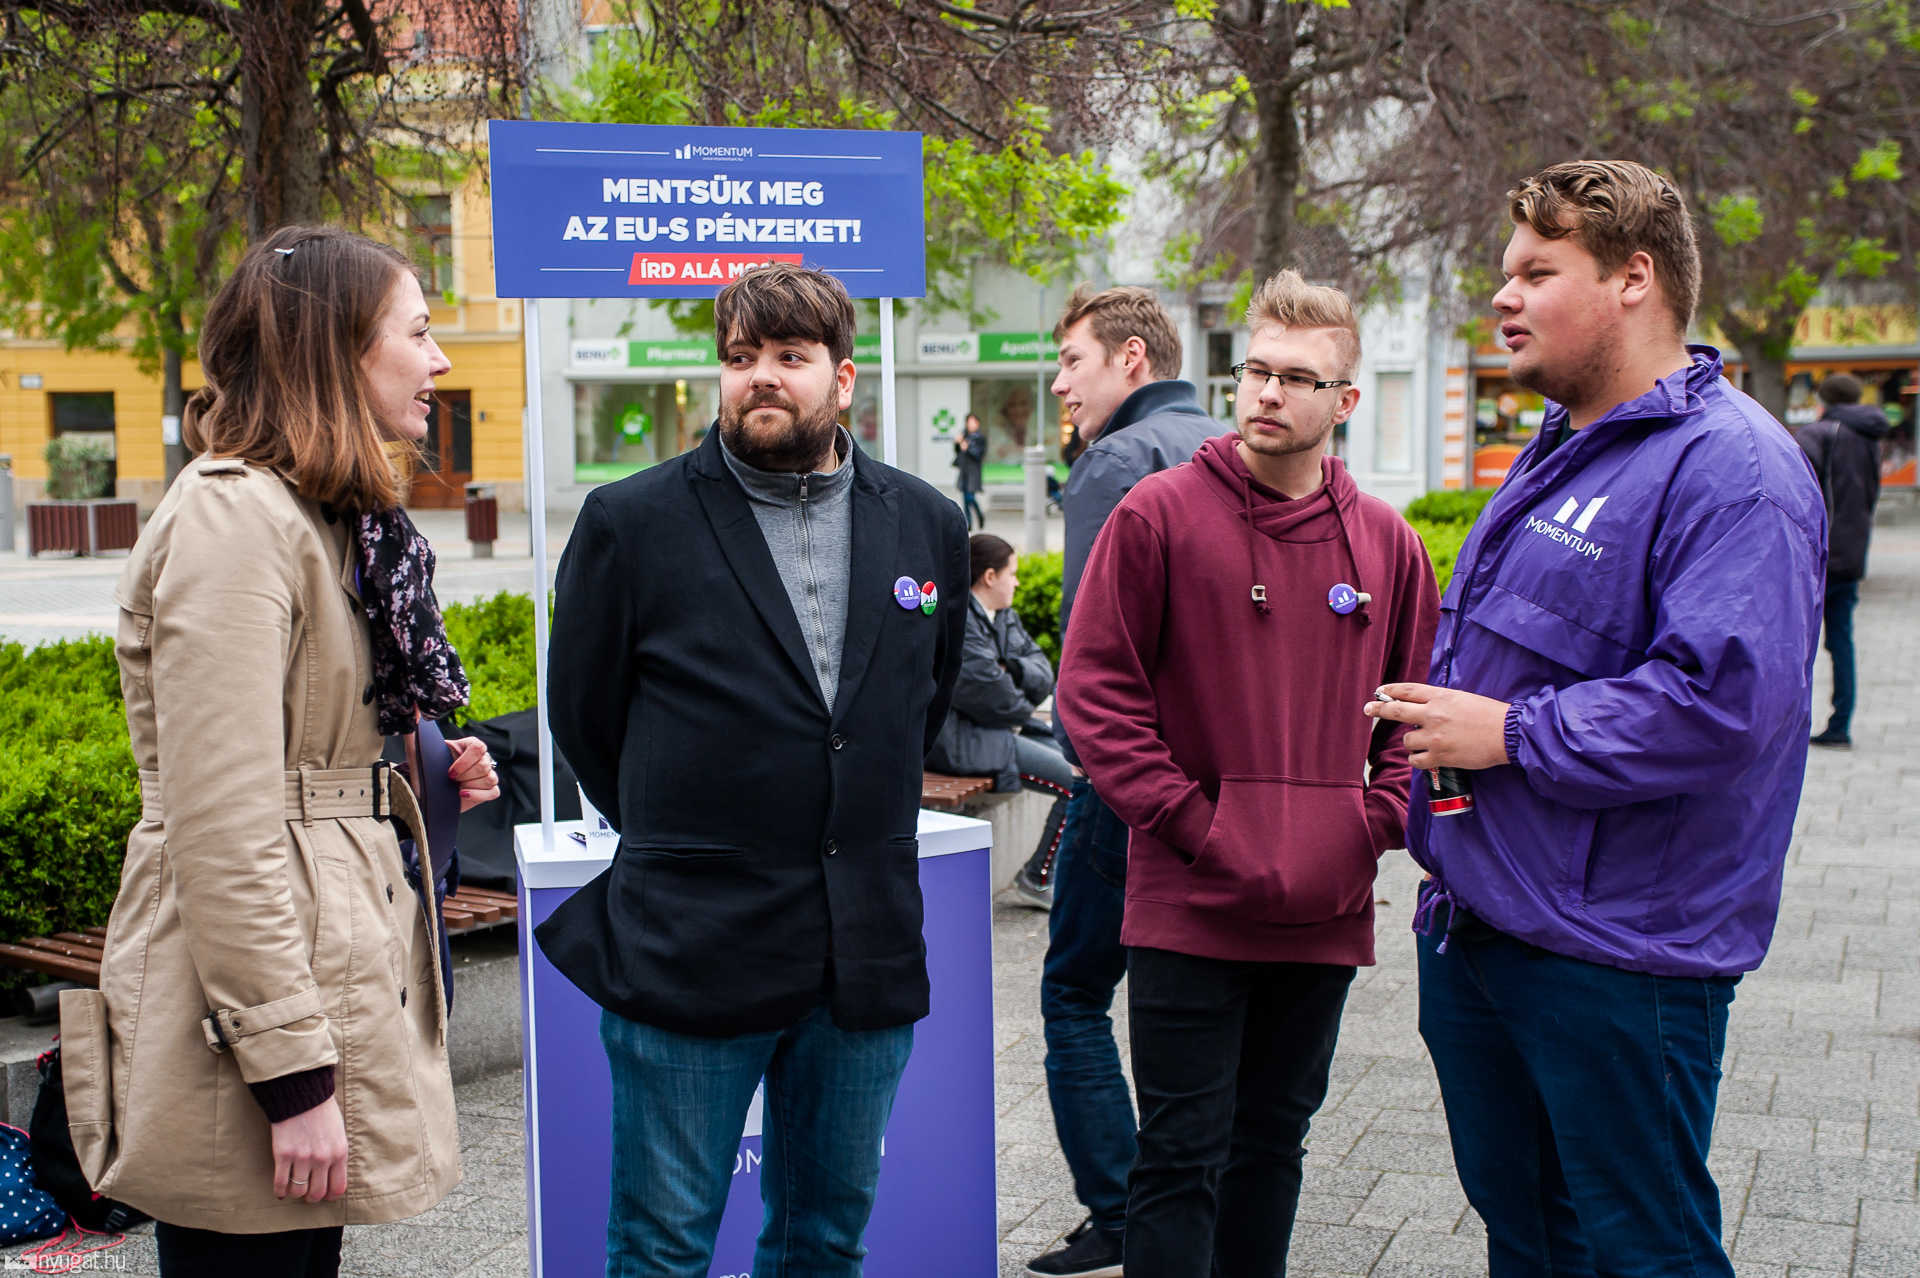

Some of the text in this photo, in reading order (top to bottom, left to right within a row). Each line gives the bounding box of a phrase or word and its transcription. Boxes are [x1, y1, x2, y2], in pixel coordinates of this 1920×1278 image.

[692, 145, 753, 158] MOMENTUM
[602, 174, 824, 206] MENTSÜK MEG
[562, 211, 862, 243] AZ EU-S PÉNZEKET!
[640, 258, 676, 279] ÍRD
[680, 258, 724, 279] ALÁ
[646, 346, 709, 363] Pharmacy
[1524, 515, 1604, 561] MOMENTUM
